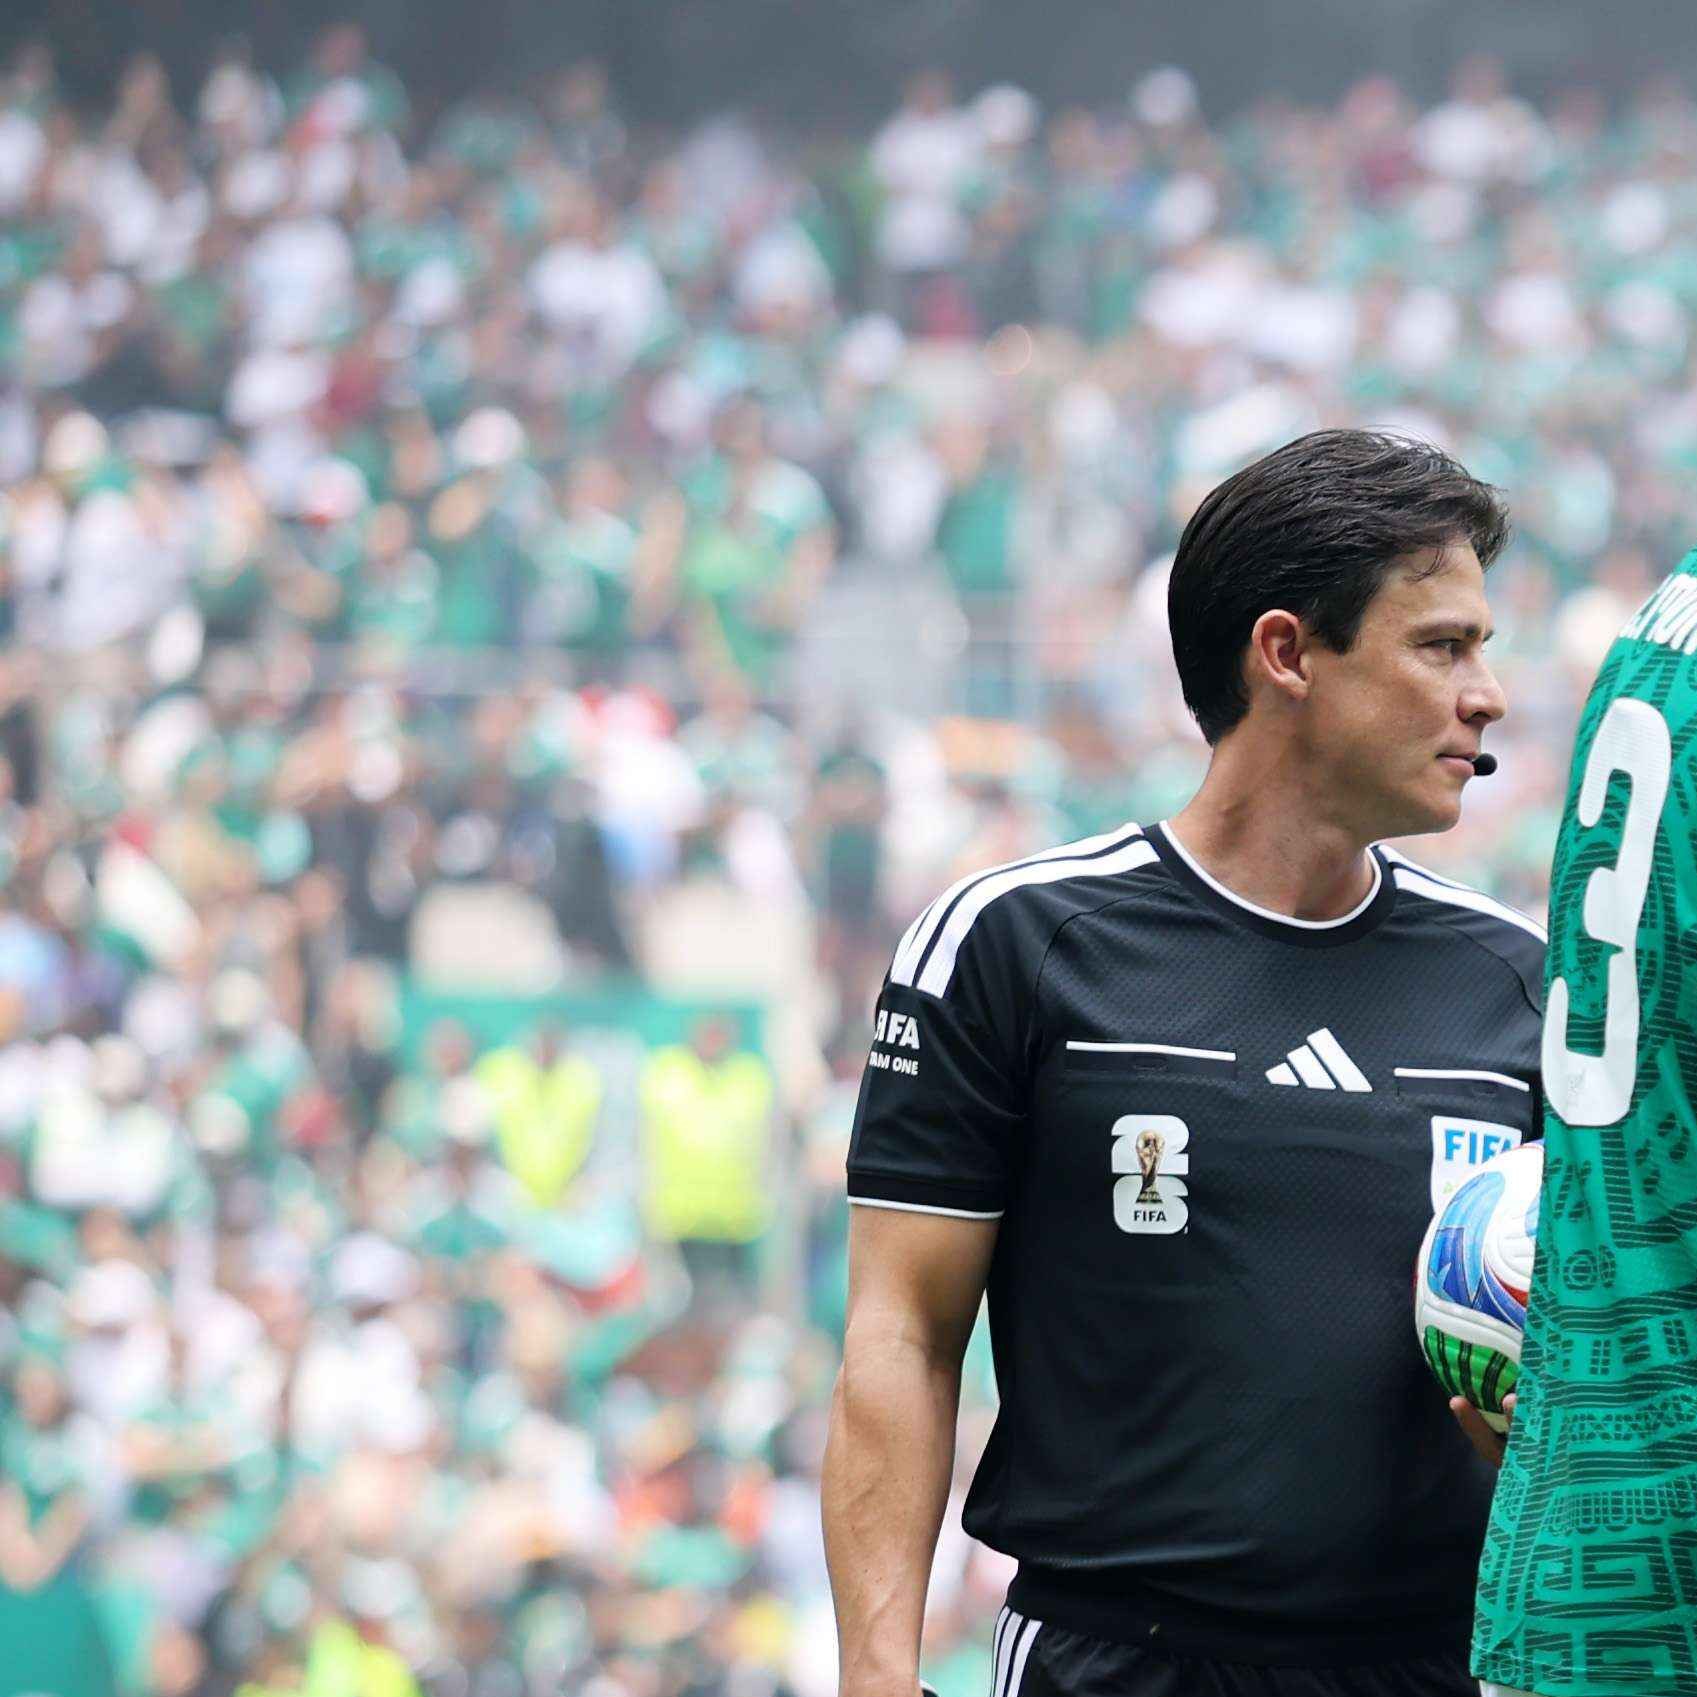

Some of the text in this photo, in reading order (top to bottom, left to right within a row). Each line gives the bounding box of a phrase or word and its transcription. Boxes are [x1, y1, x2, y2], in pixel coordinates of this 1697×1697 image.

[1542, 698, 1671, 1127] 3
[874, 1010, 920, 1050] IFA
[868, 1051, 919, 1076] AM ONE
[1133, 1210, 1167, 1222] FIFA
